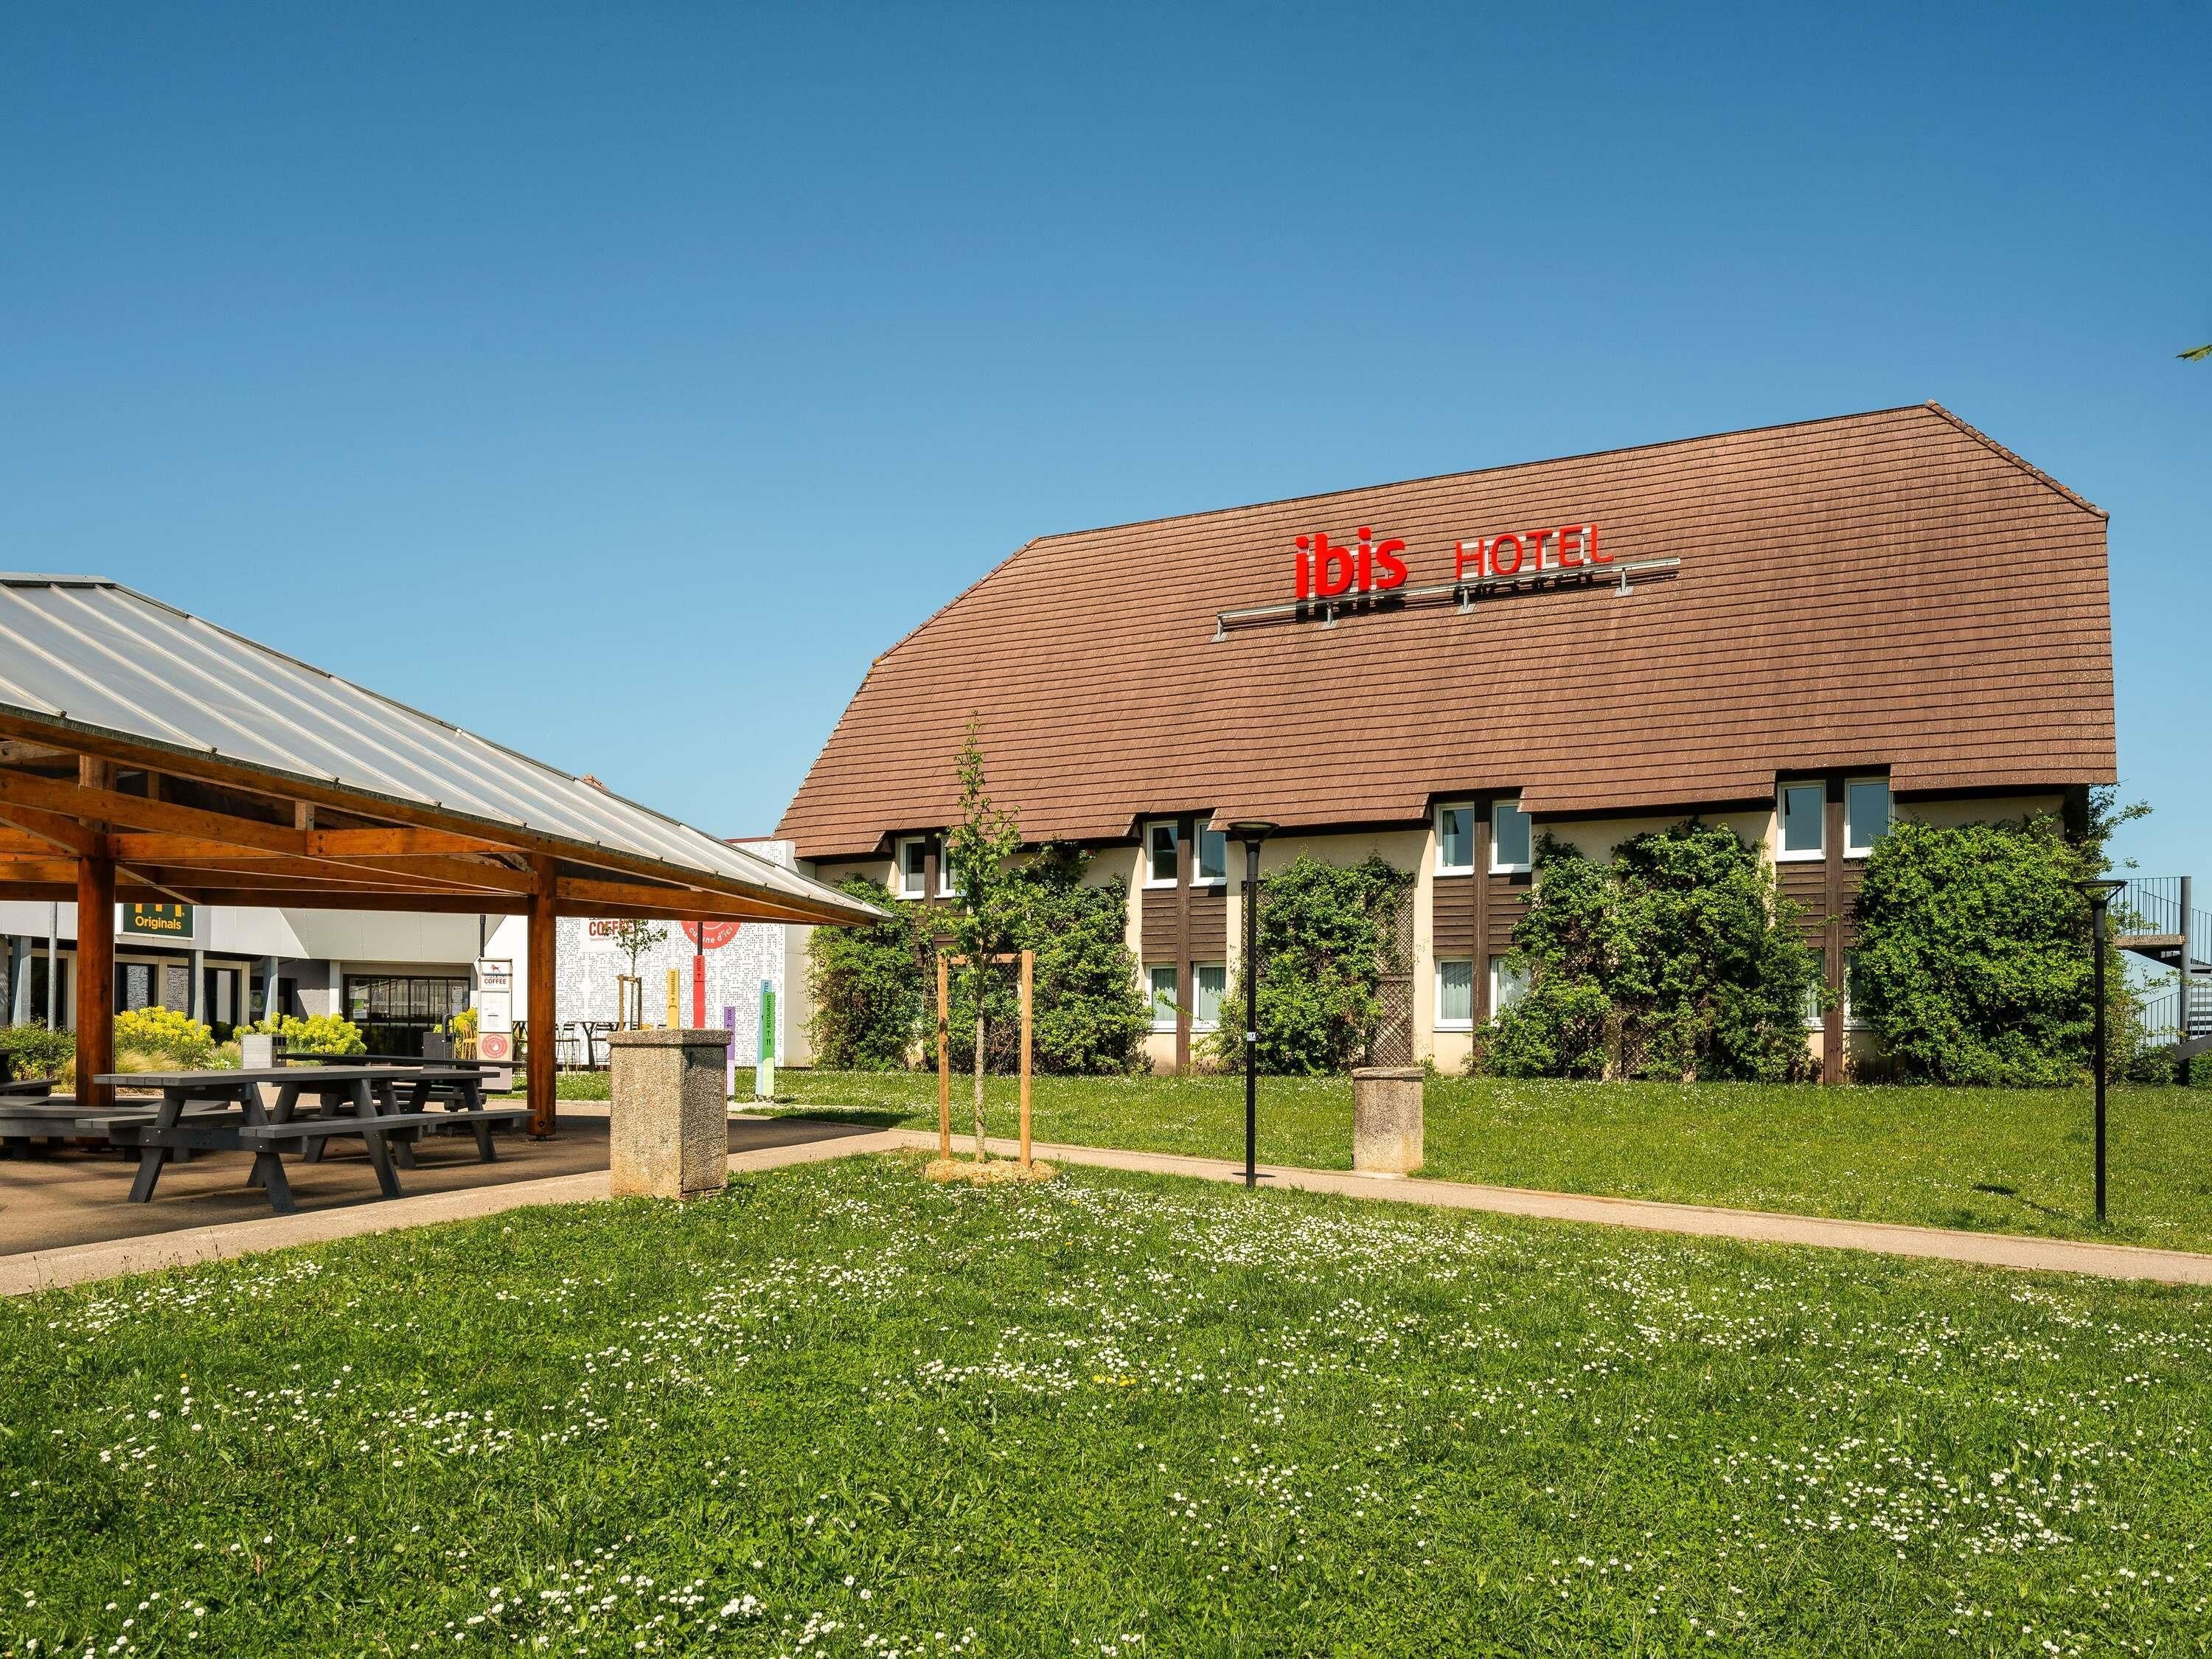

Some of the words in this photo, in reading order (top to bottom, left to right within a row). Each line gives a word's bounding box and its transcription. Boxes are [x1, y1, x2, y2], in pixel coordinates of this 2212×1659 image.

[1295, 526, 1408, 599] ibis
[1455, 523, 1614, 580] HOTEL
[135, 916, 181, 930] Originals
[689, 928, 715, 944] cuine
[717, 925, 734, 942] d'ici
